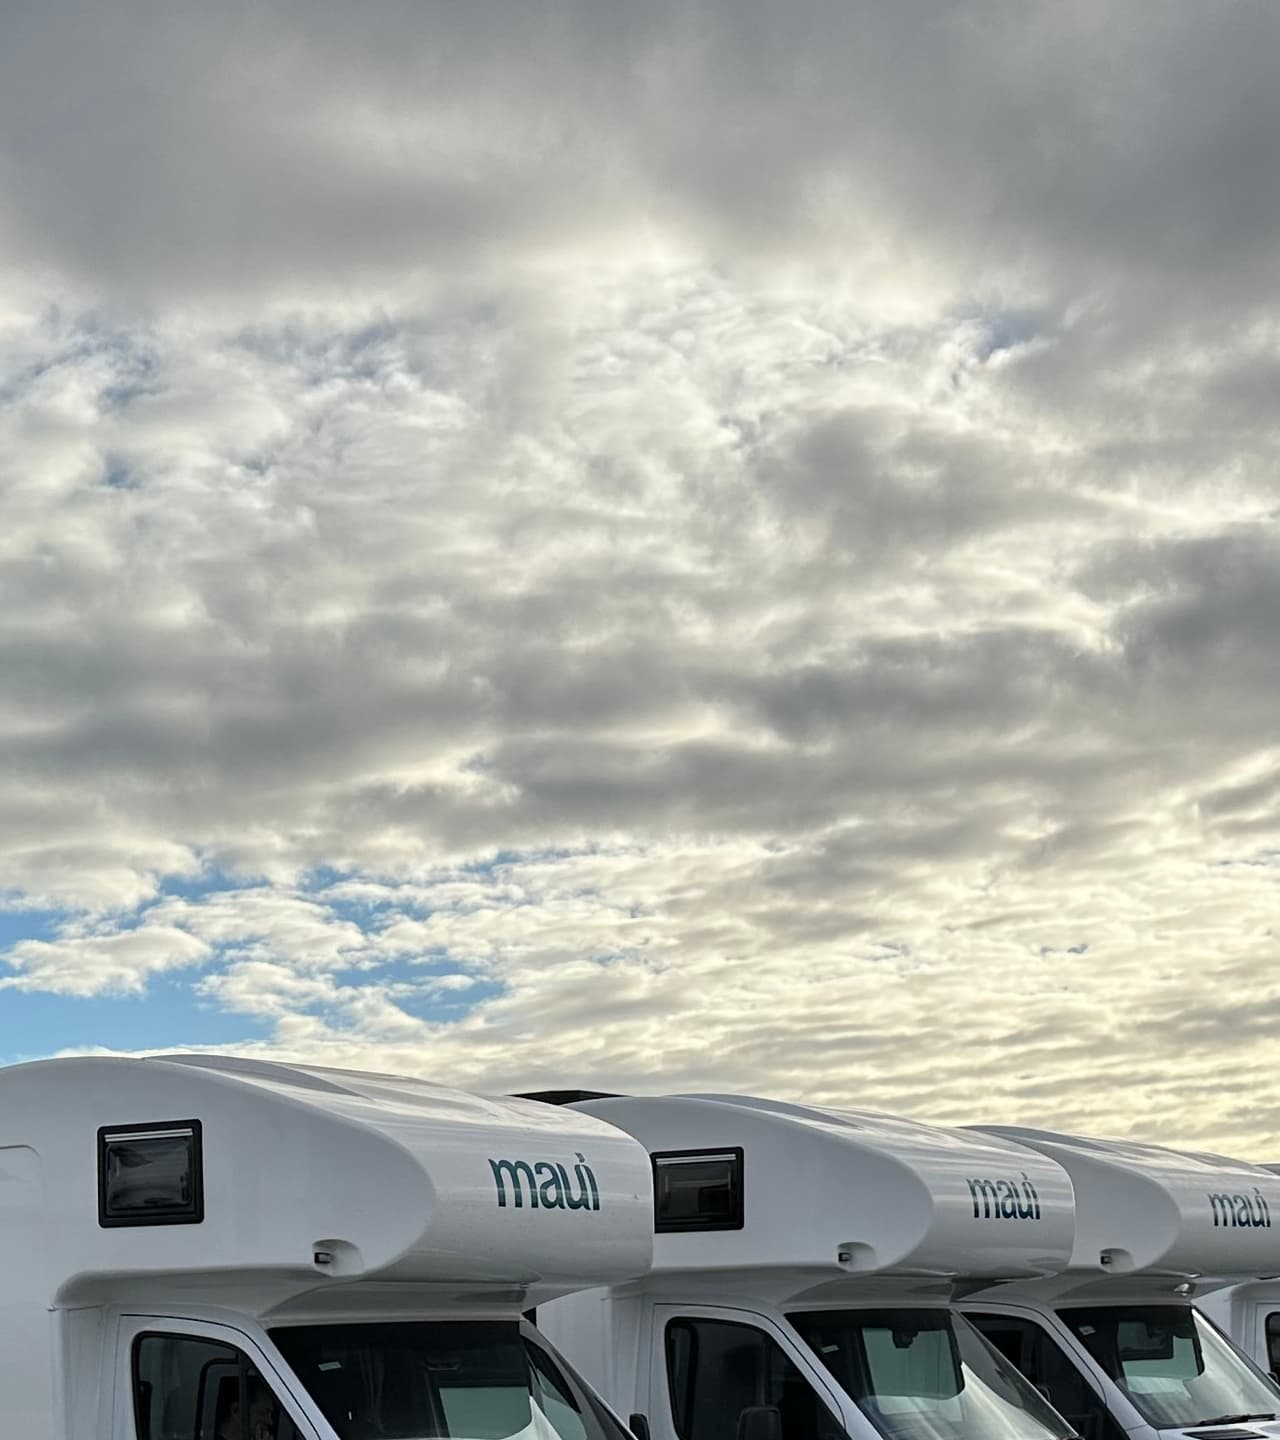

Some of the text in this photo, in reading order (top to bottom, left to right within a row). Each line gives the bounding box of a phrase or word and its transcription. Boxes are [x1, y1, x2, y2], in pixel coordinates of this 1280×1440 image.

[488, 1152, 600, 1210] maui
[966, 1171, 1040, 1219] maui
[1207, 1187, 1271, 1227] maui
